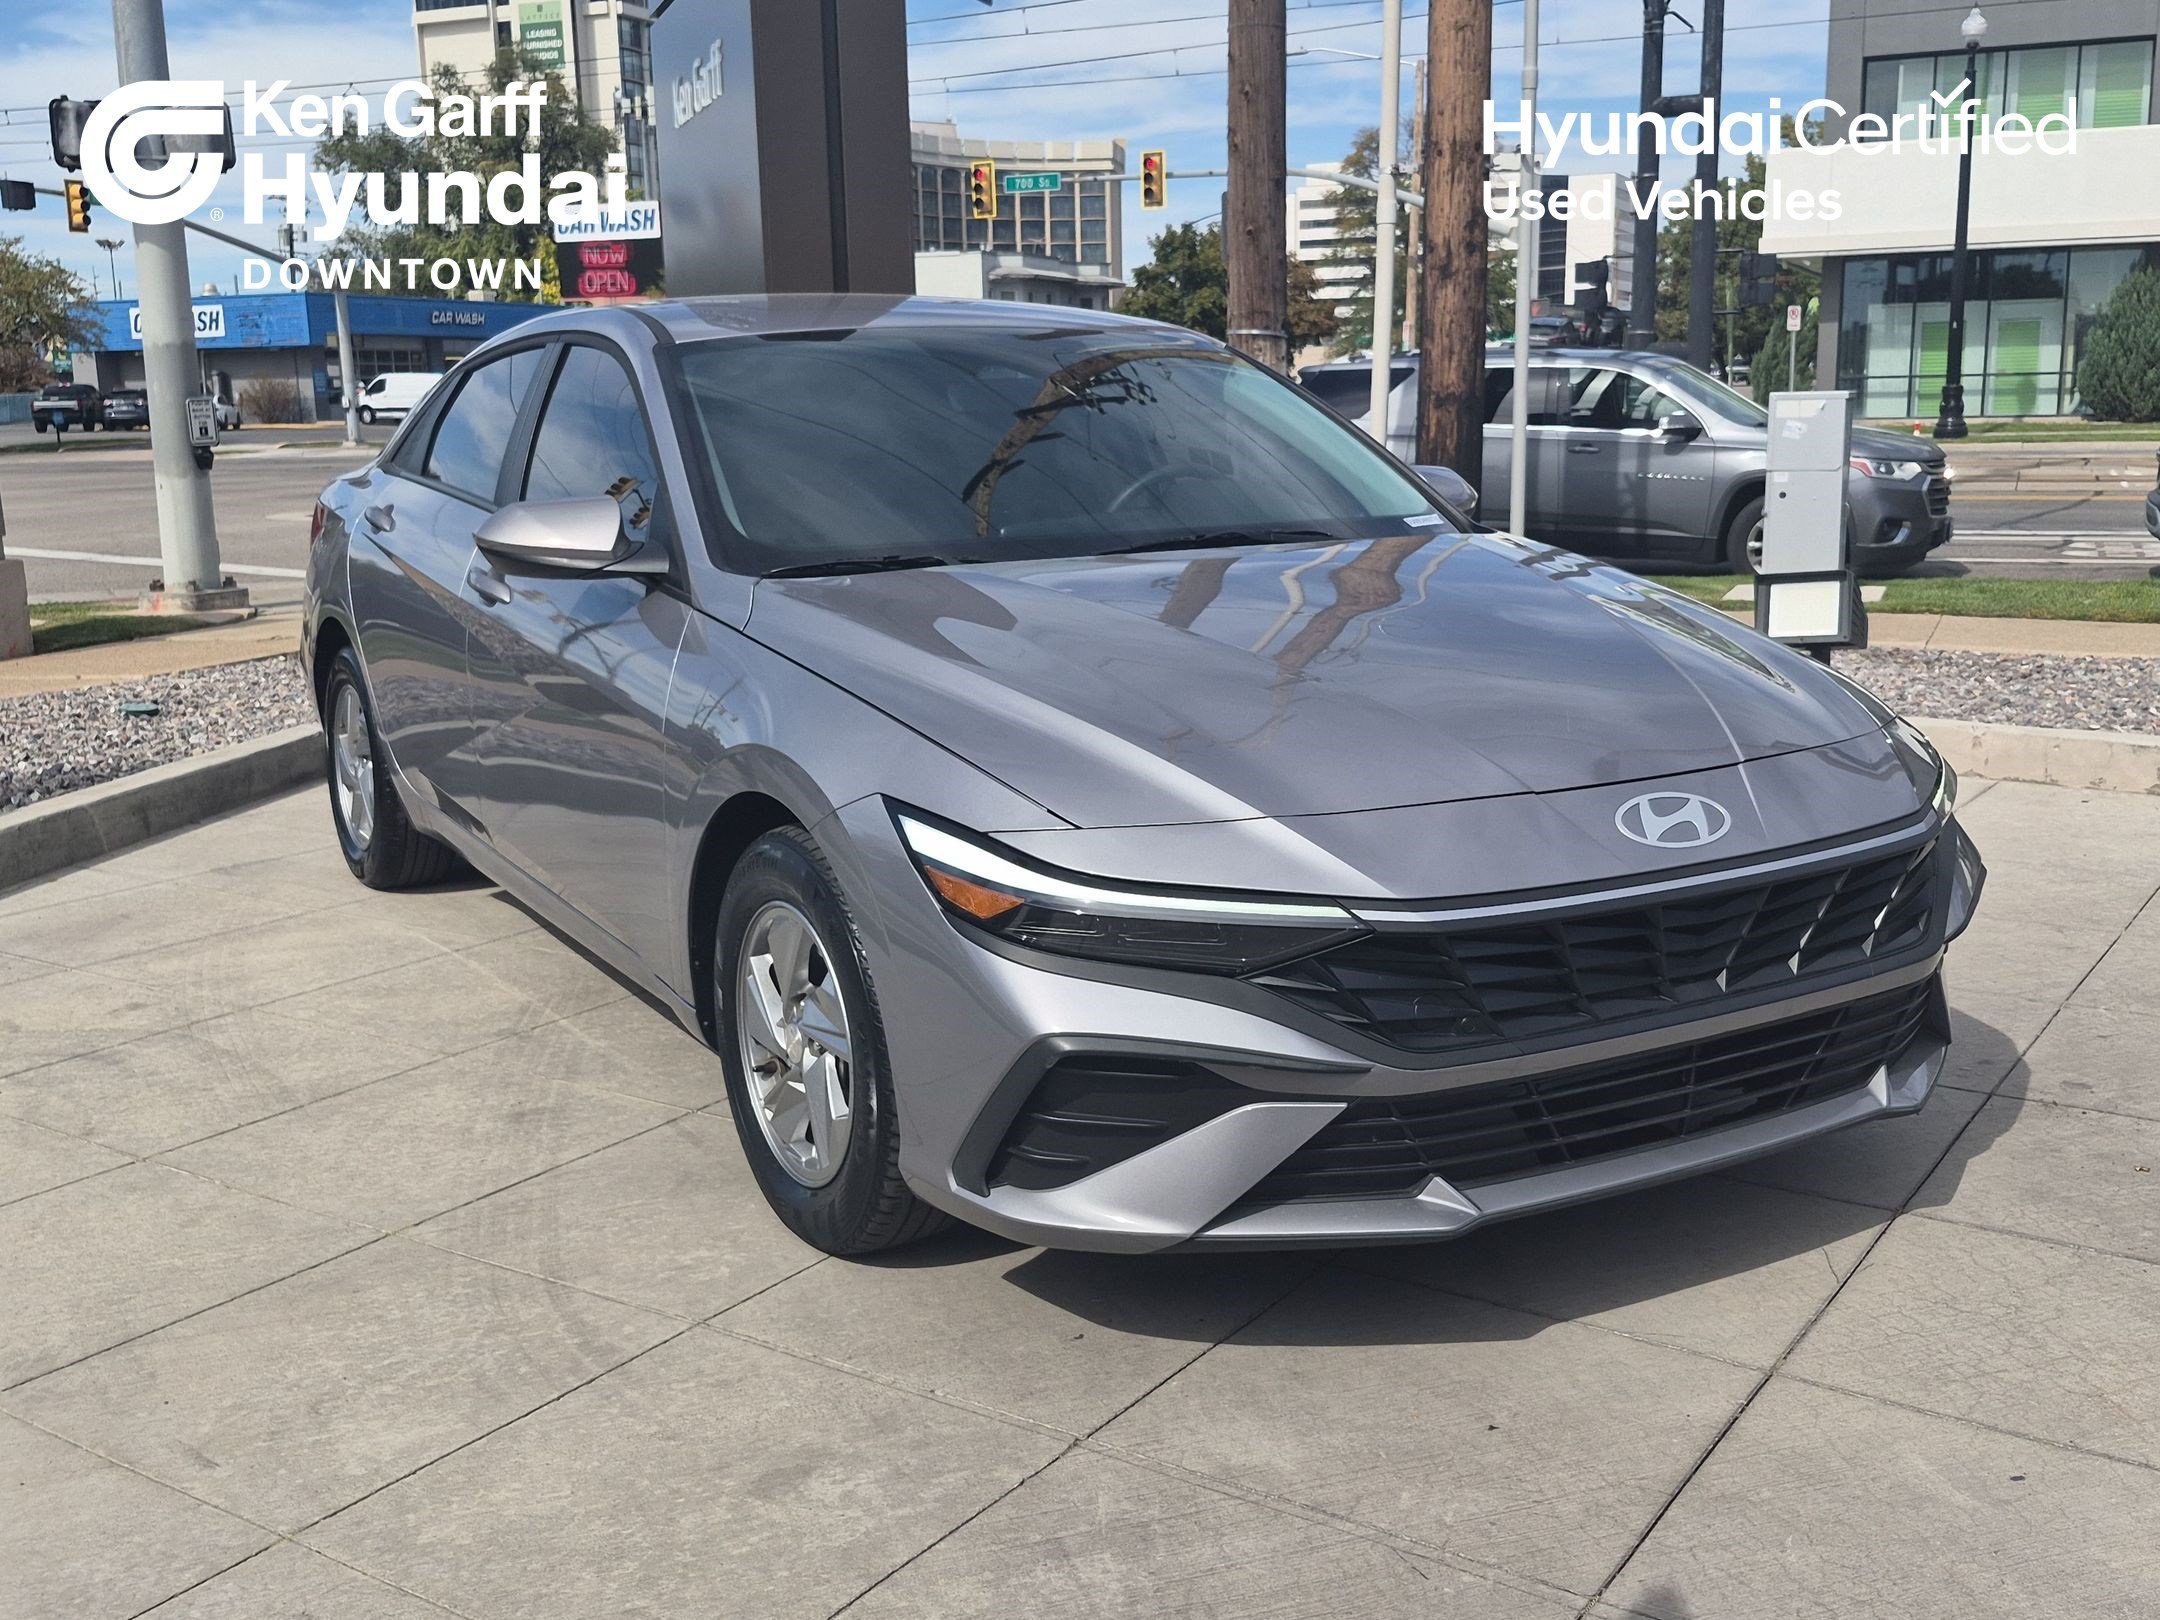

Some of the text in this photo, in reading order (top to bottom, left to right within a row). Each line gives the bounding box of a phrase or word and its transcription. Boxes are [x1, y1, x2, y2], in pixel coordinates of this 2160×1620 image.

[526, 28, 557, 39] LEASING
[672, 39, 722, 128] Ken Garff
[1015, 178, 1033, 189] 700
[583, 247, 625, 263] NOW
[585, 271, 629, 293] OPEN
[432, 311, 485, 325] CAR WASH
